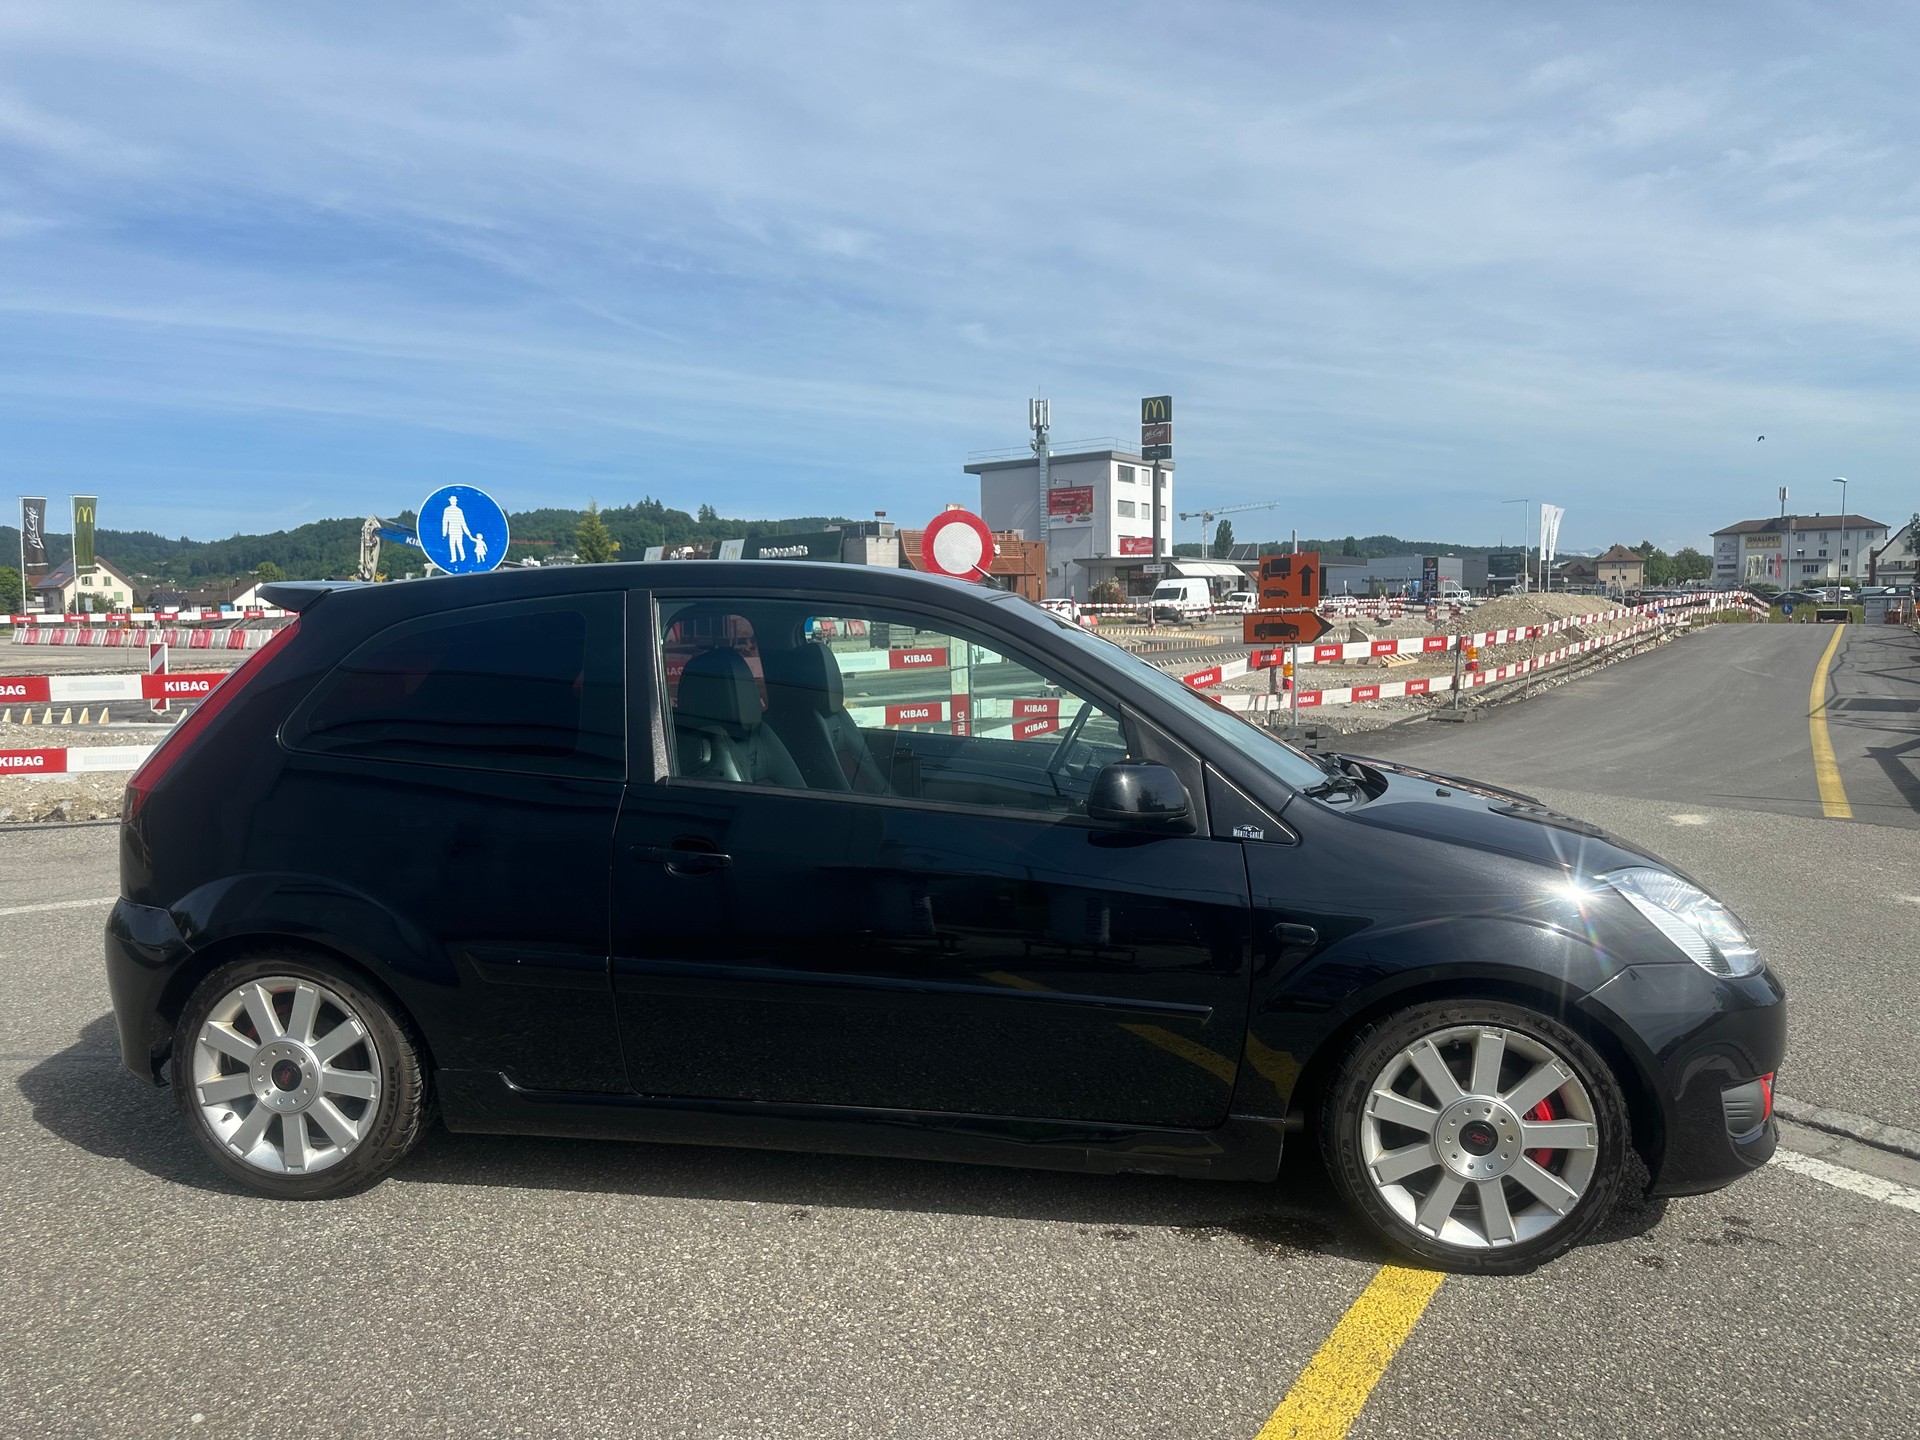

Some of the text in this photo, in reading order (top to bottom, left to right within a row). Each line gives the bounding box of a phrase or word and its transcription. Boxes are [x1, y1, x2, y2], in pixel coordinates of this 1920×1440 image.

[1321, 648, 1336, 656] KIBAG
[1377, 644, 1391, 652] KIBAG
[904, 654, 932, 663] KIBAG
[1194, 674, 1213, 685] KIBAG
[164, 681, 209, 691] KIBAG
[1358, 689, 1373, 697] KIBAG
[1024, 704, 1047, 712] KIBAG
[900, 708, 928, 718] KIBAG
[1025, 720, 1048, 734] KIBAG
[0, 756, 44, 767] KIBAG
